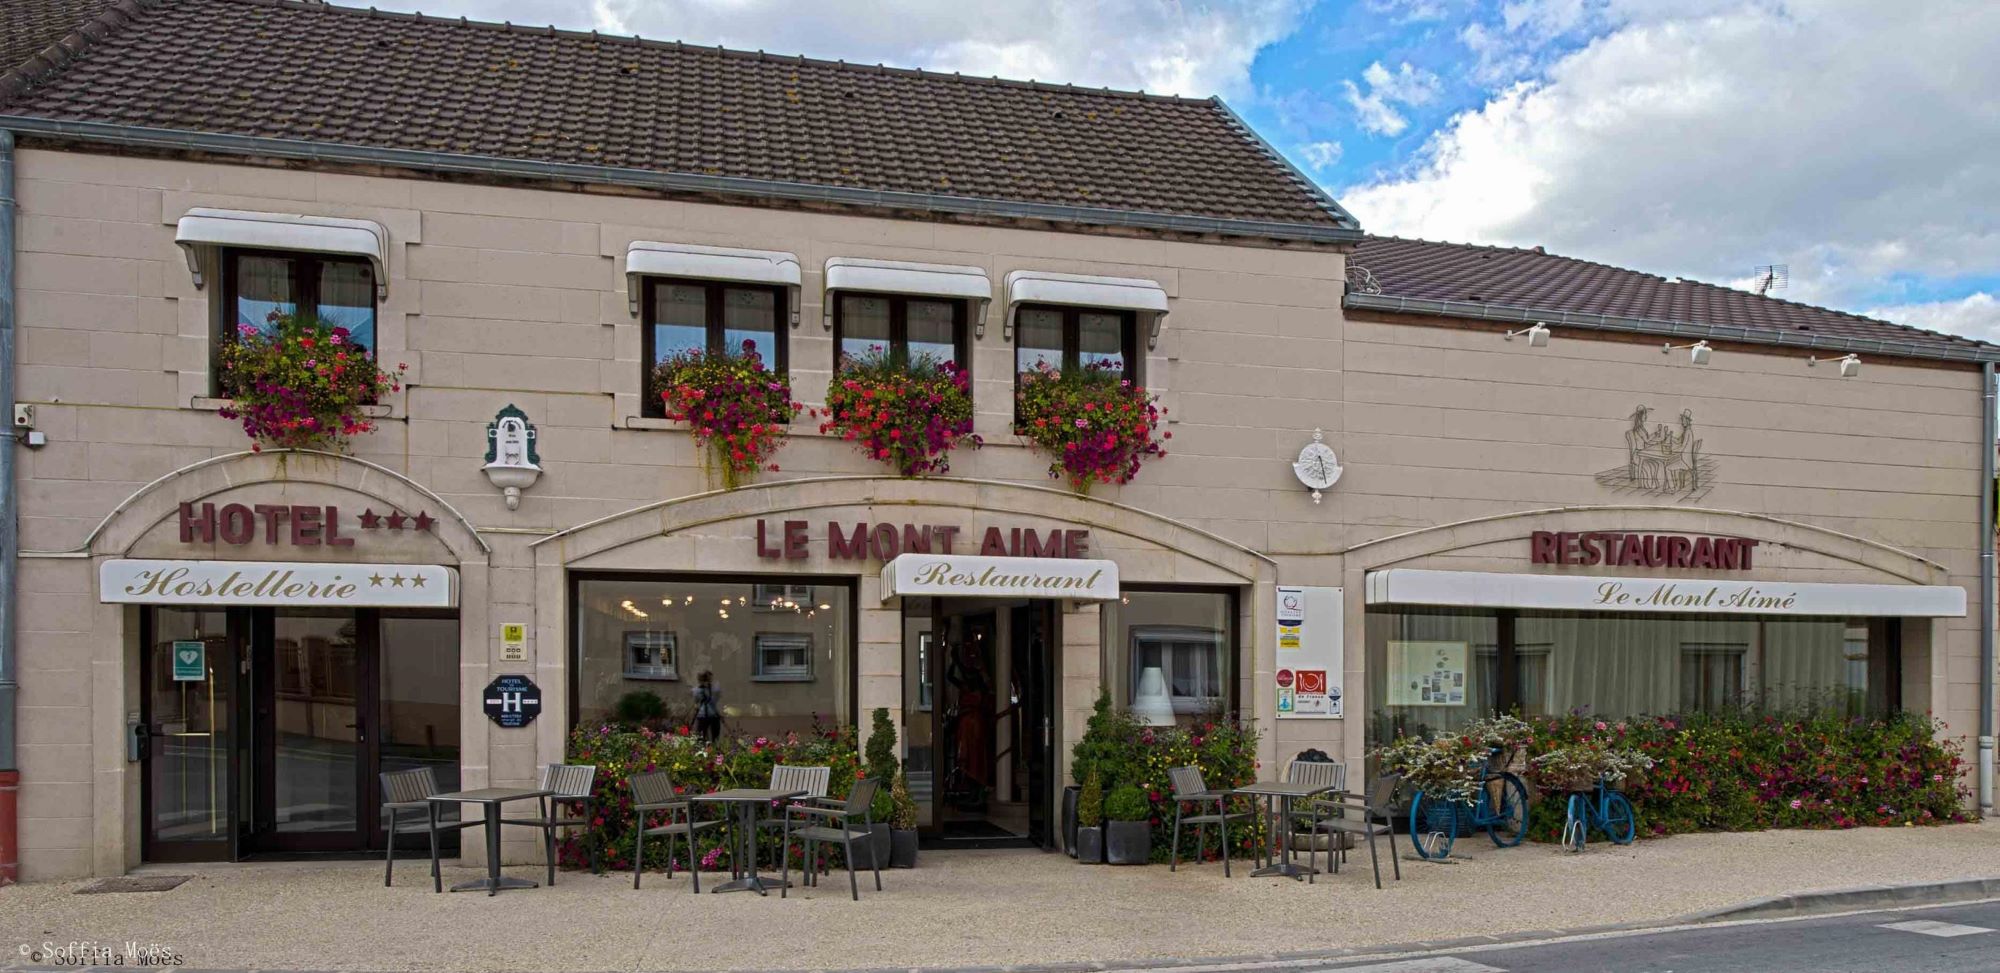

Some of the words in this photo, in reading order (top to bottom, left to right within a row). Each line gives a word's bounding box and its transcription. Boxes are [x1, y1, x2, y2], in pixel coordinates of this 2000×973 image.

[179, 502, 355, 546] HOTEL
[756, 519, 809, 559] LE
[828, 522, 960, 560] MONT
[980, 526, 1089, 559] AIME
[1531, 531, 1759, 570] RESTAURANT
[125, 567, 357, 599] Hostellerie
[914, 562, 1103, 590] Restaurant
[1593, 581, 1631, 605] Le
[1635, 583, 1718, 607] Mont
[1718, 586, 1798, 609] Aimé
[502, 692, 522, 712] H
